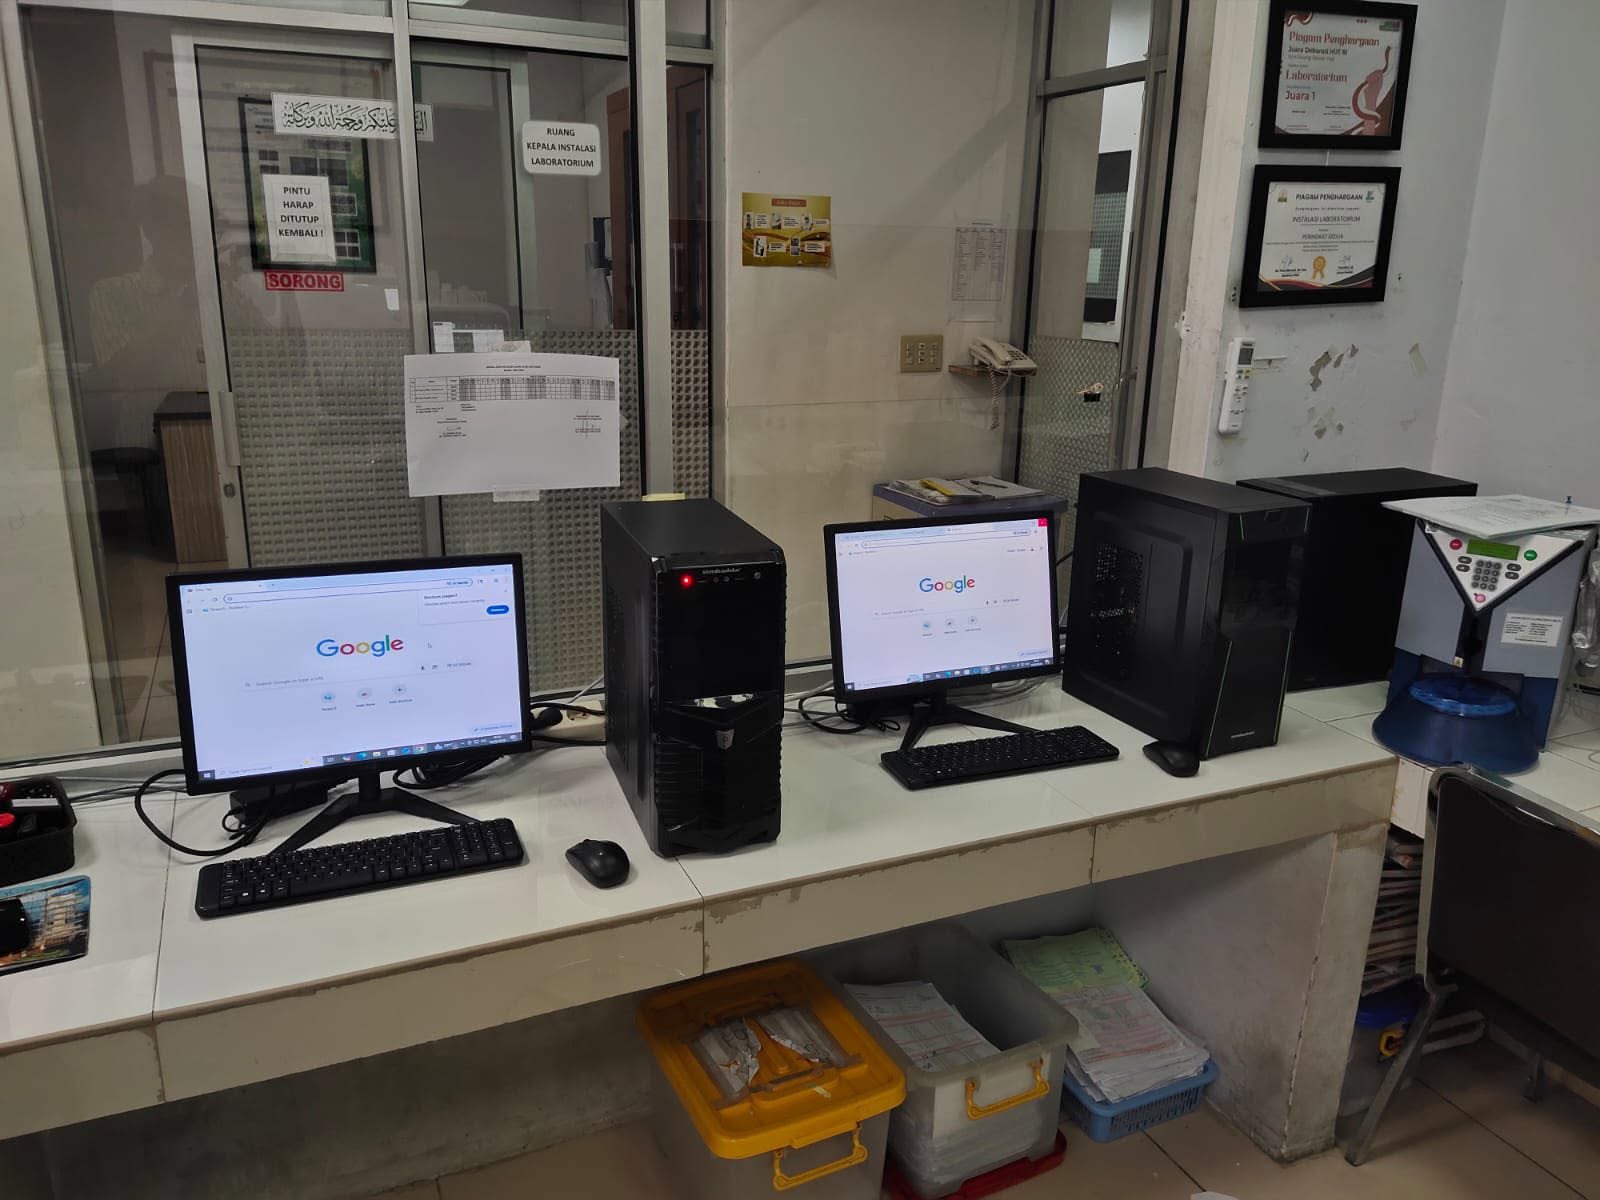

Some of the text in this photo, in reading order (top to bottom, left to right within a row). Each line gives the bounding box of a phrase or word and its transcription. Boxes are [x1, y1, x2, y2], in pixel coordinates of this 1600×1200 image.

[1285, 90, 1310, 101] Juara
[547, 128, 575, 137] RUANG
[527, 142, 596, 153] KEPALA INSTALASI
[531, 157, 594, 168] LABORATORIUM
[283, 186, 311, 196] PINTU
[283, 201, 314, 210] HARAP
[280, 215, 320, 224] DITUTUP
[278, 229, 318, 238] KEMBALI
[268, 273, 341, 289] SORONG
[918, 575, 976, 593] Google
[316, 635, 404, 657] Google
